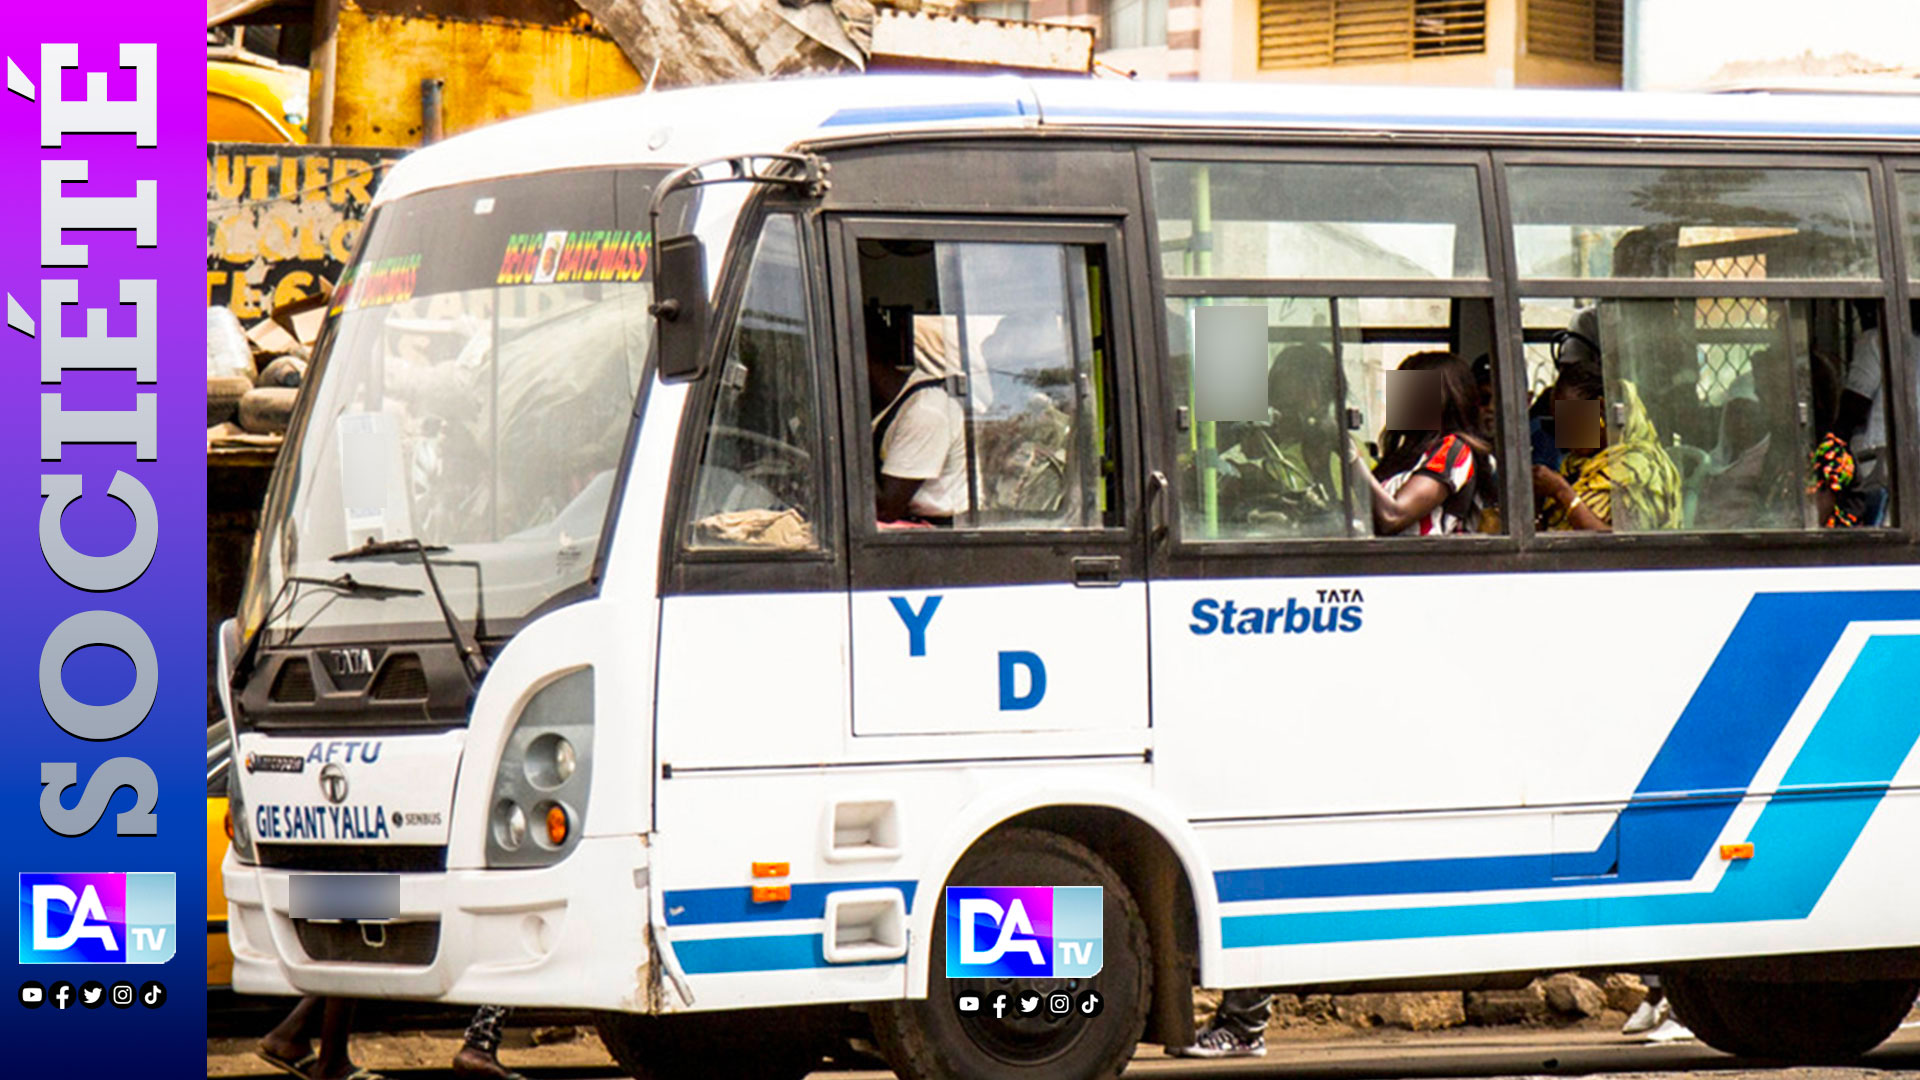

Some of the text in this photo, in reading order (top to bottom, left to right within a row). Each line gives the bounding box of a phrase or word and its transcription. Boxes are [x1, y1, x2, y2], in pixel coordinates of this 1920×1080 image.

[207, 155, 374, 204] UTIER
[1316, 589, 1364, 603] TATA
[888, 595, 943, 657] Y
[1188, 597, 1363, 635] Starbus
[998, 650, 1047, 711] D
[306, 741, 382, 764] AFTU
[256, 804, 282, 838] GIE
[328, 805, 390, 840] YALLA
